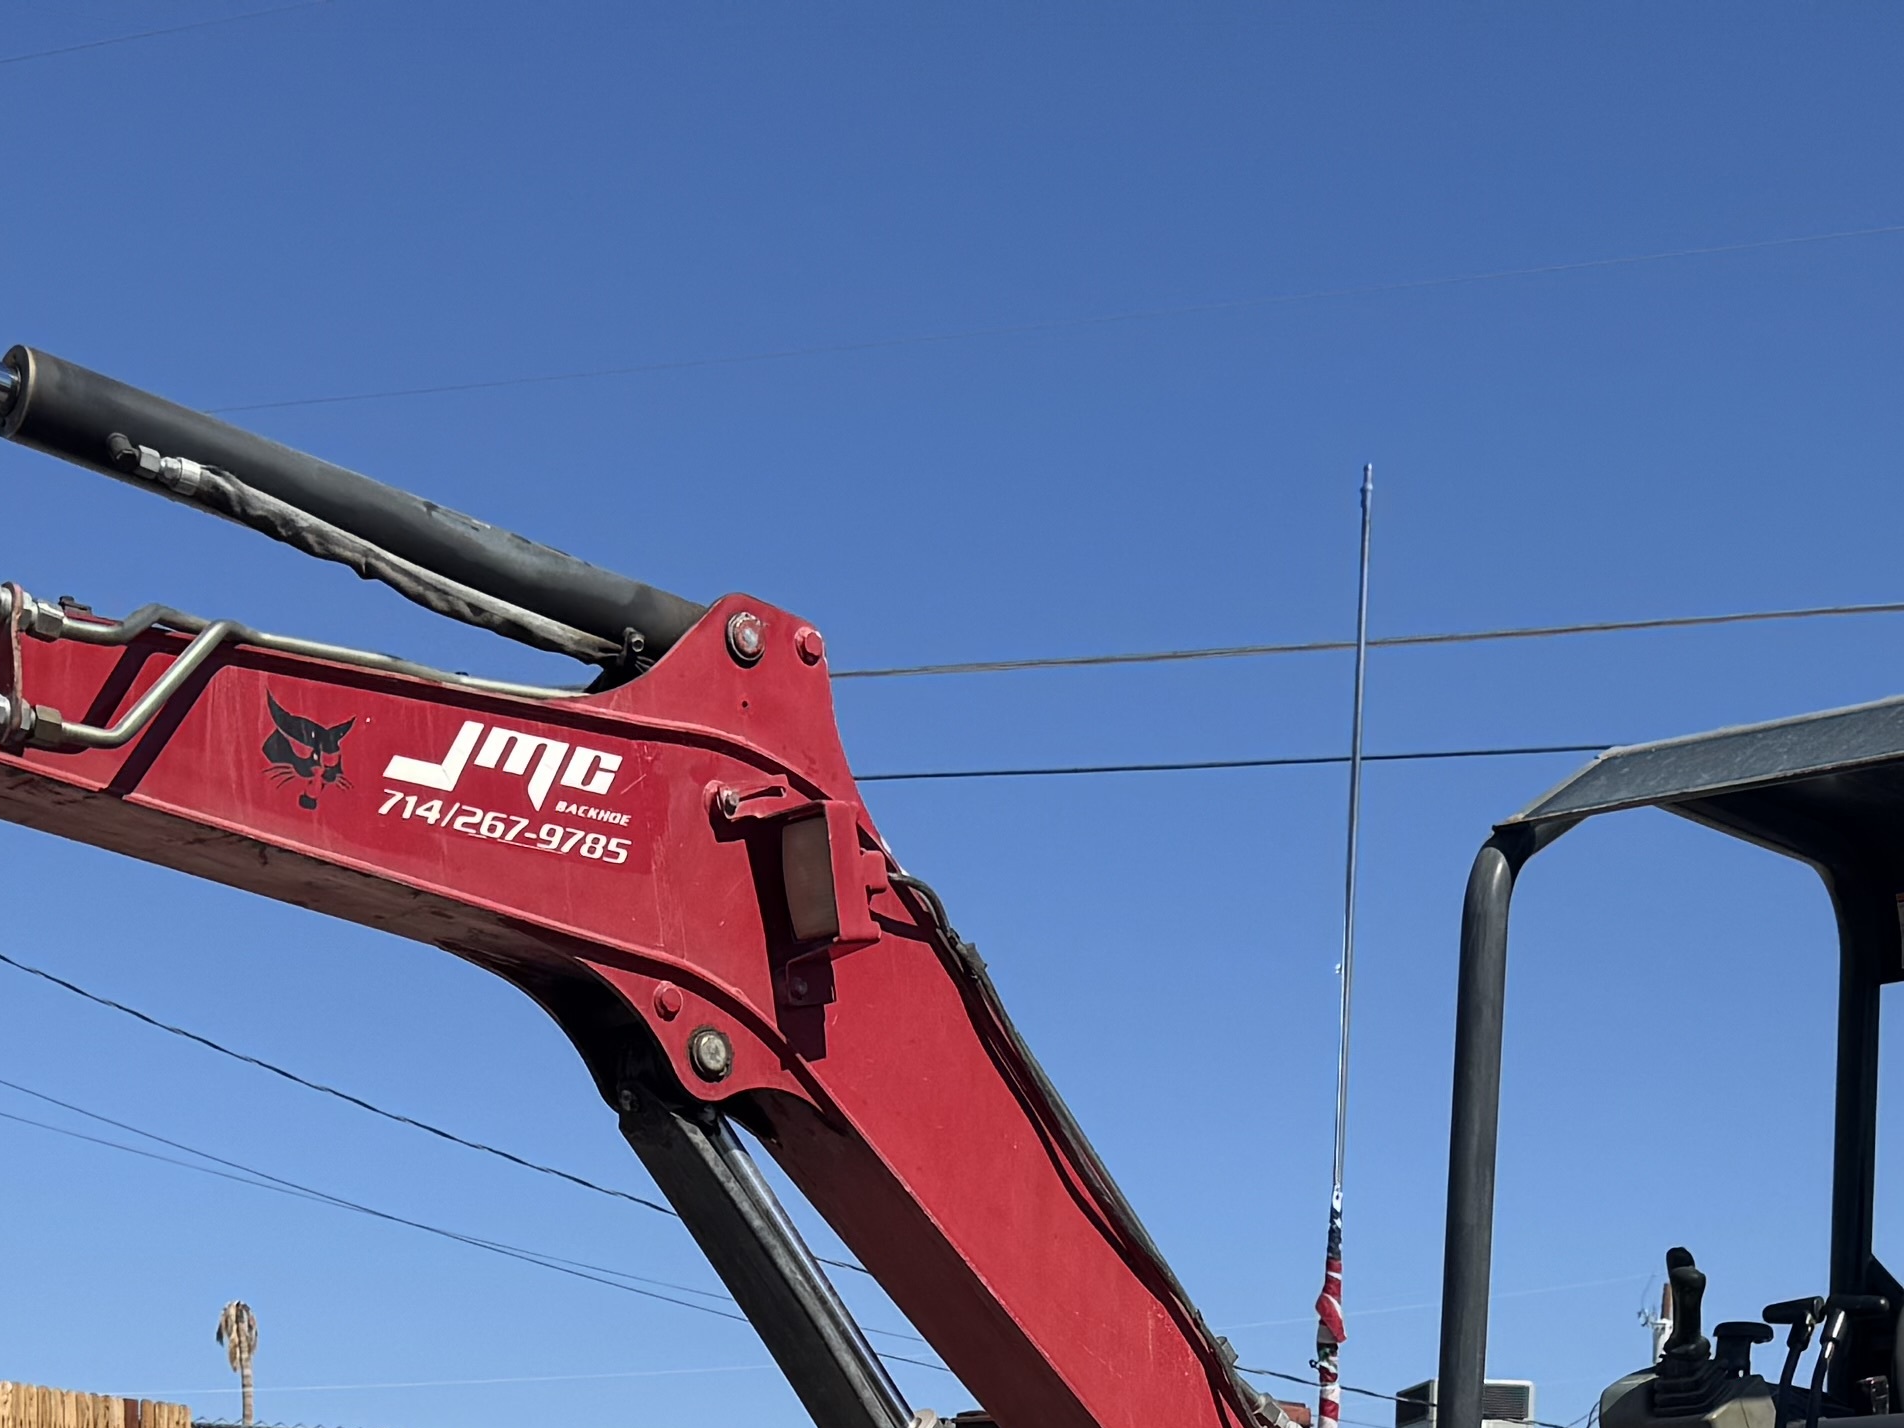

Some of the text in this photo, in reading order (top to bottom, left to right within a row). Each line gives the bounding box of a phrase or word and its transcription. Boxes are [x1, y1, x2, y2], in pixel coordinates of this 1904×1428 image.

[382, 720, 623, 812] JMC
[378, 788, 632, 864] 714/267-9785
[554, 801, 632, 827] BACKHOE
